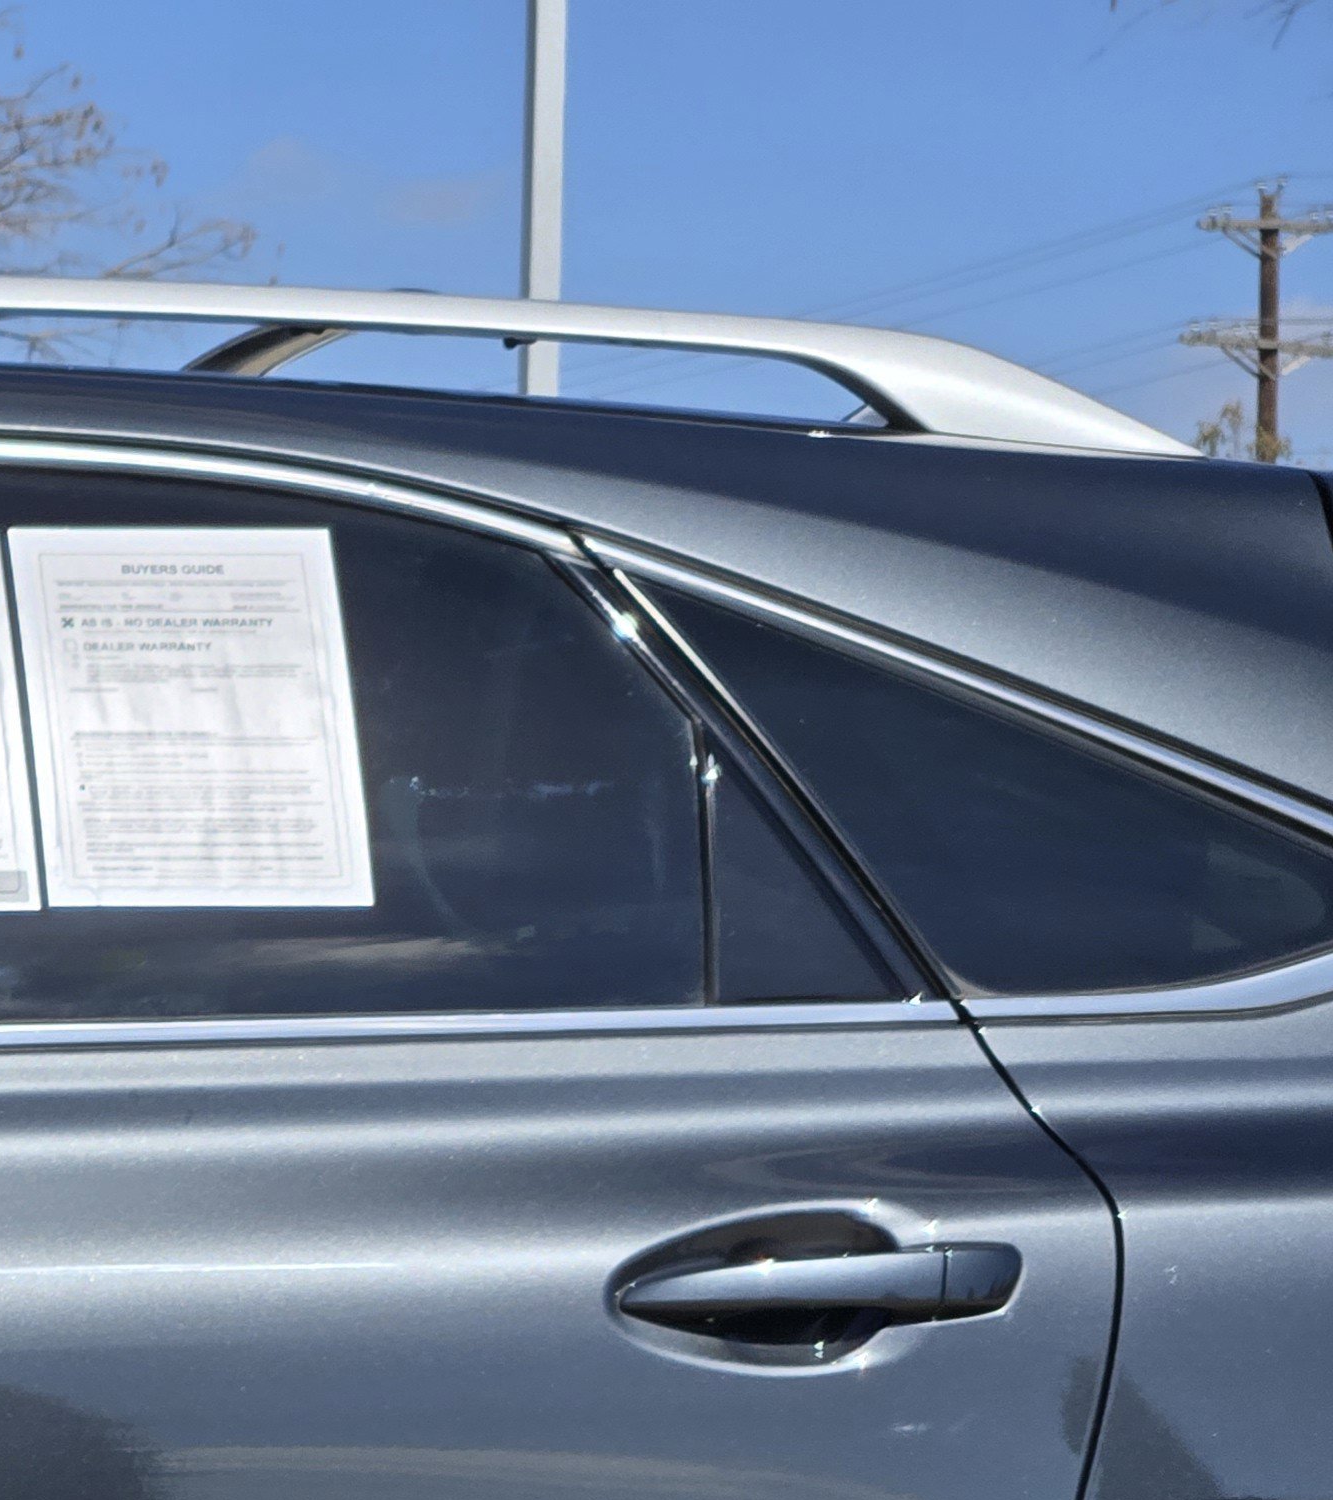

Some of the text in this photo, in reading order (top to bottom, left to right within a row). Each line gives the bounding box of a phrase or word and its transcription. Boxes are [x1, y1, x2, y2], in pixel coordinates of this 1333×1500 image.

[121, 564, 225, 575] BUYERS GUIDE
[81, 618, 97, 627] AS
[124, 618, 143, 627] NO
[146, 618, 198, 627] DEALER
[202, 618, 273, 627] WARRANTY
[83, 641, 212, 652] DEALER WARRANTY
